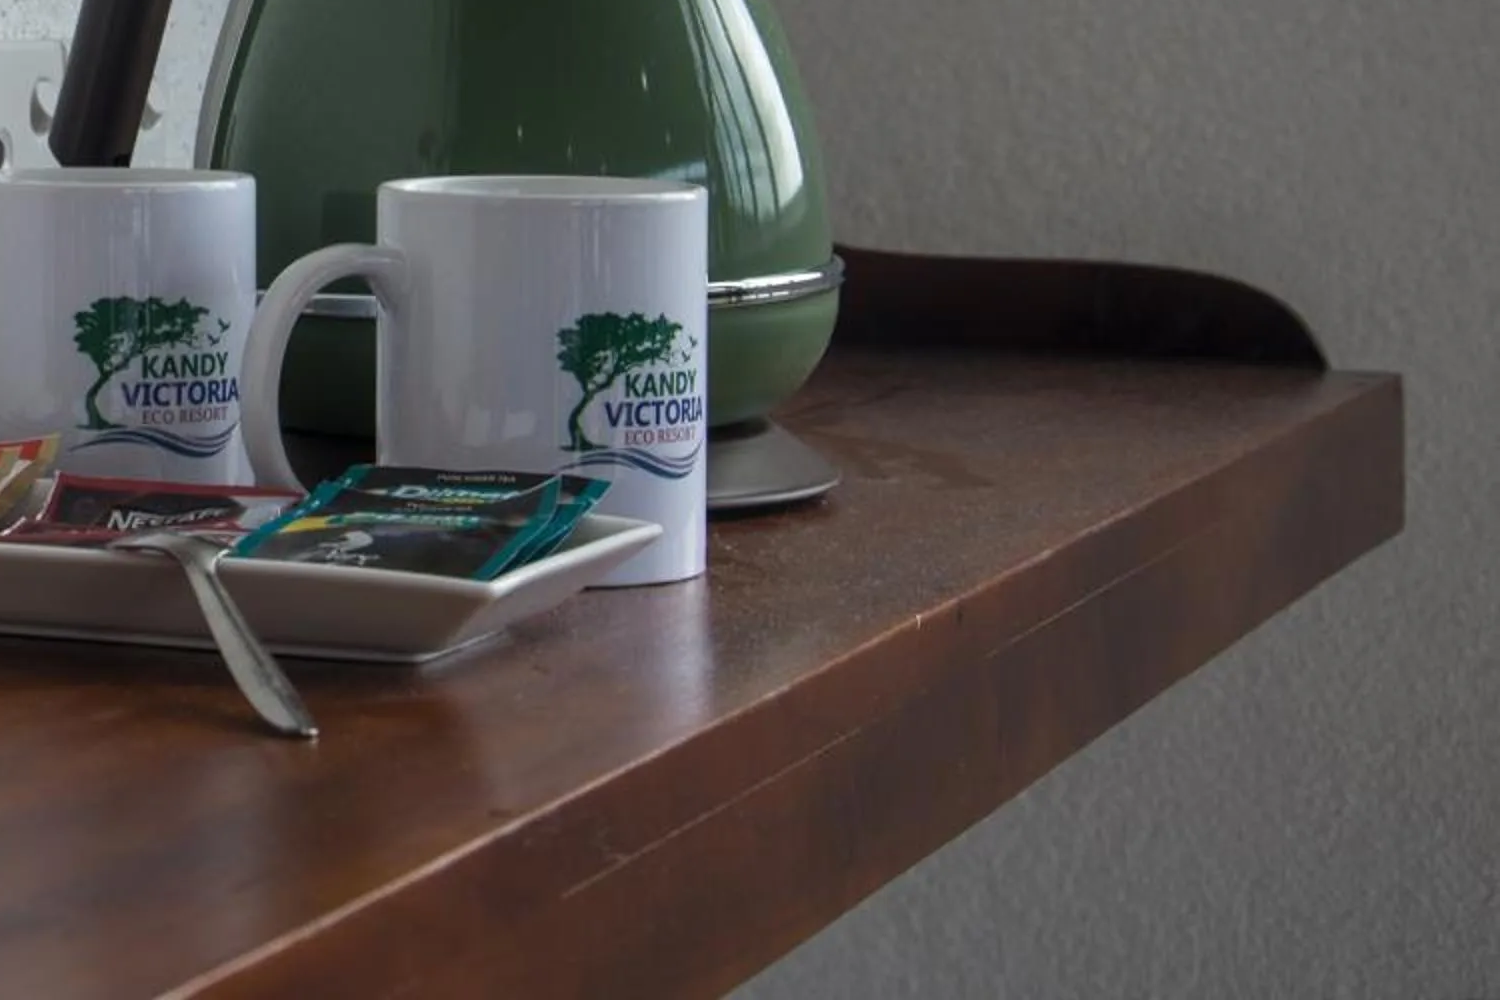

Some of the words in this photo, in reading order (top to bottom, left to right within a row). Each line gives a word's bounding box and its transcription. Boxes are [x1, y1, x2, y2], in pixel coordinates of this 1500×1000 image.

[141, 351, 228, 379] KANDY
[121, 376, 239, 407] VICTORIA
[624, 368, 697, 399] KANDY
[142, 408, 175, 425] ECO
[179, 406, 229, 423] RESORT
[605, 396, 703, 428] VICTORIA
[624, 429, 655, 446] ECO
[658, 425, 697, 444] RESORT
